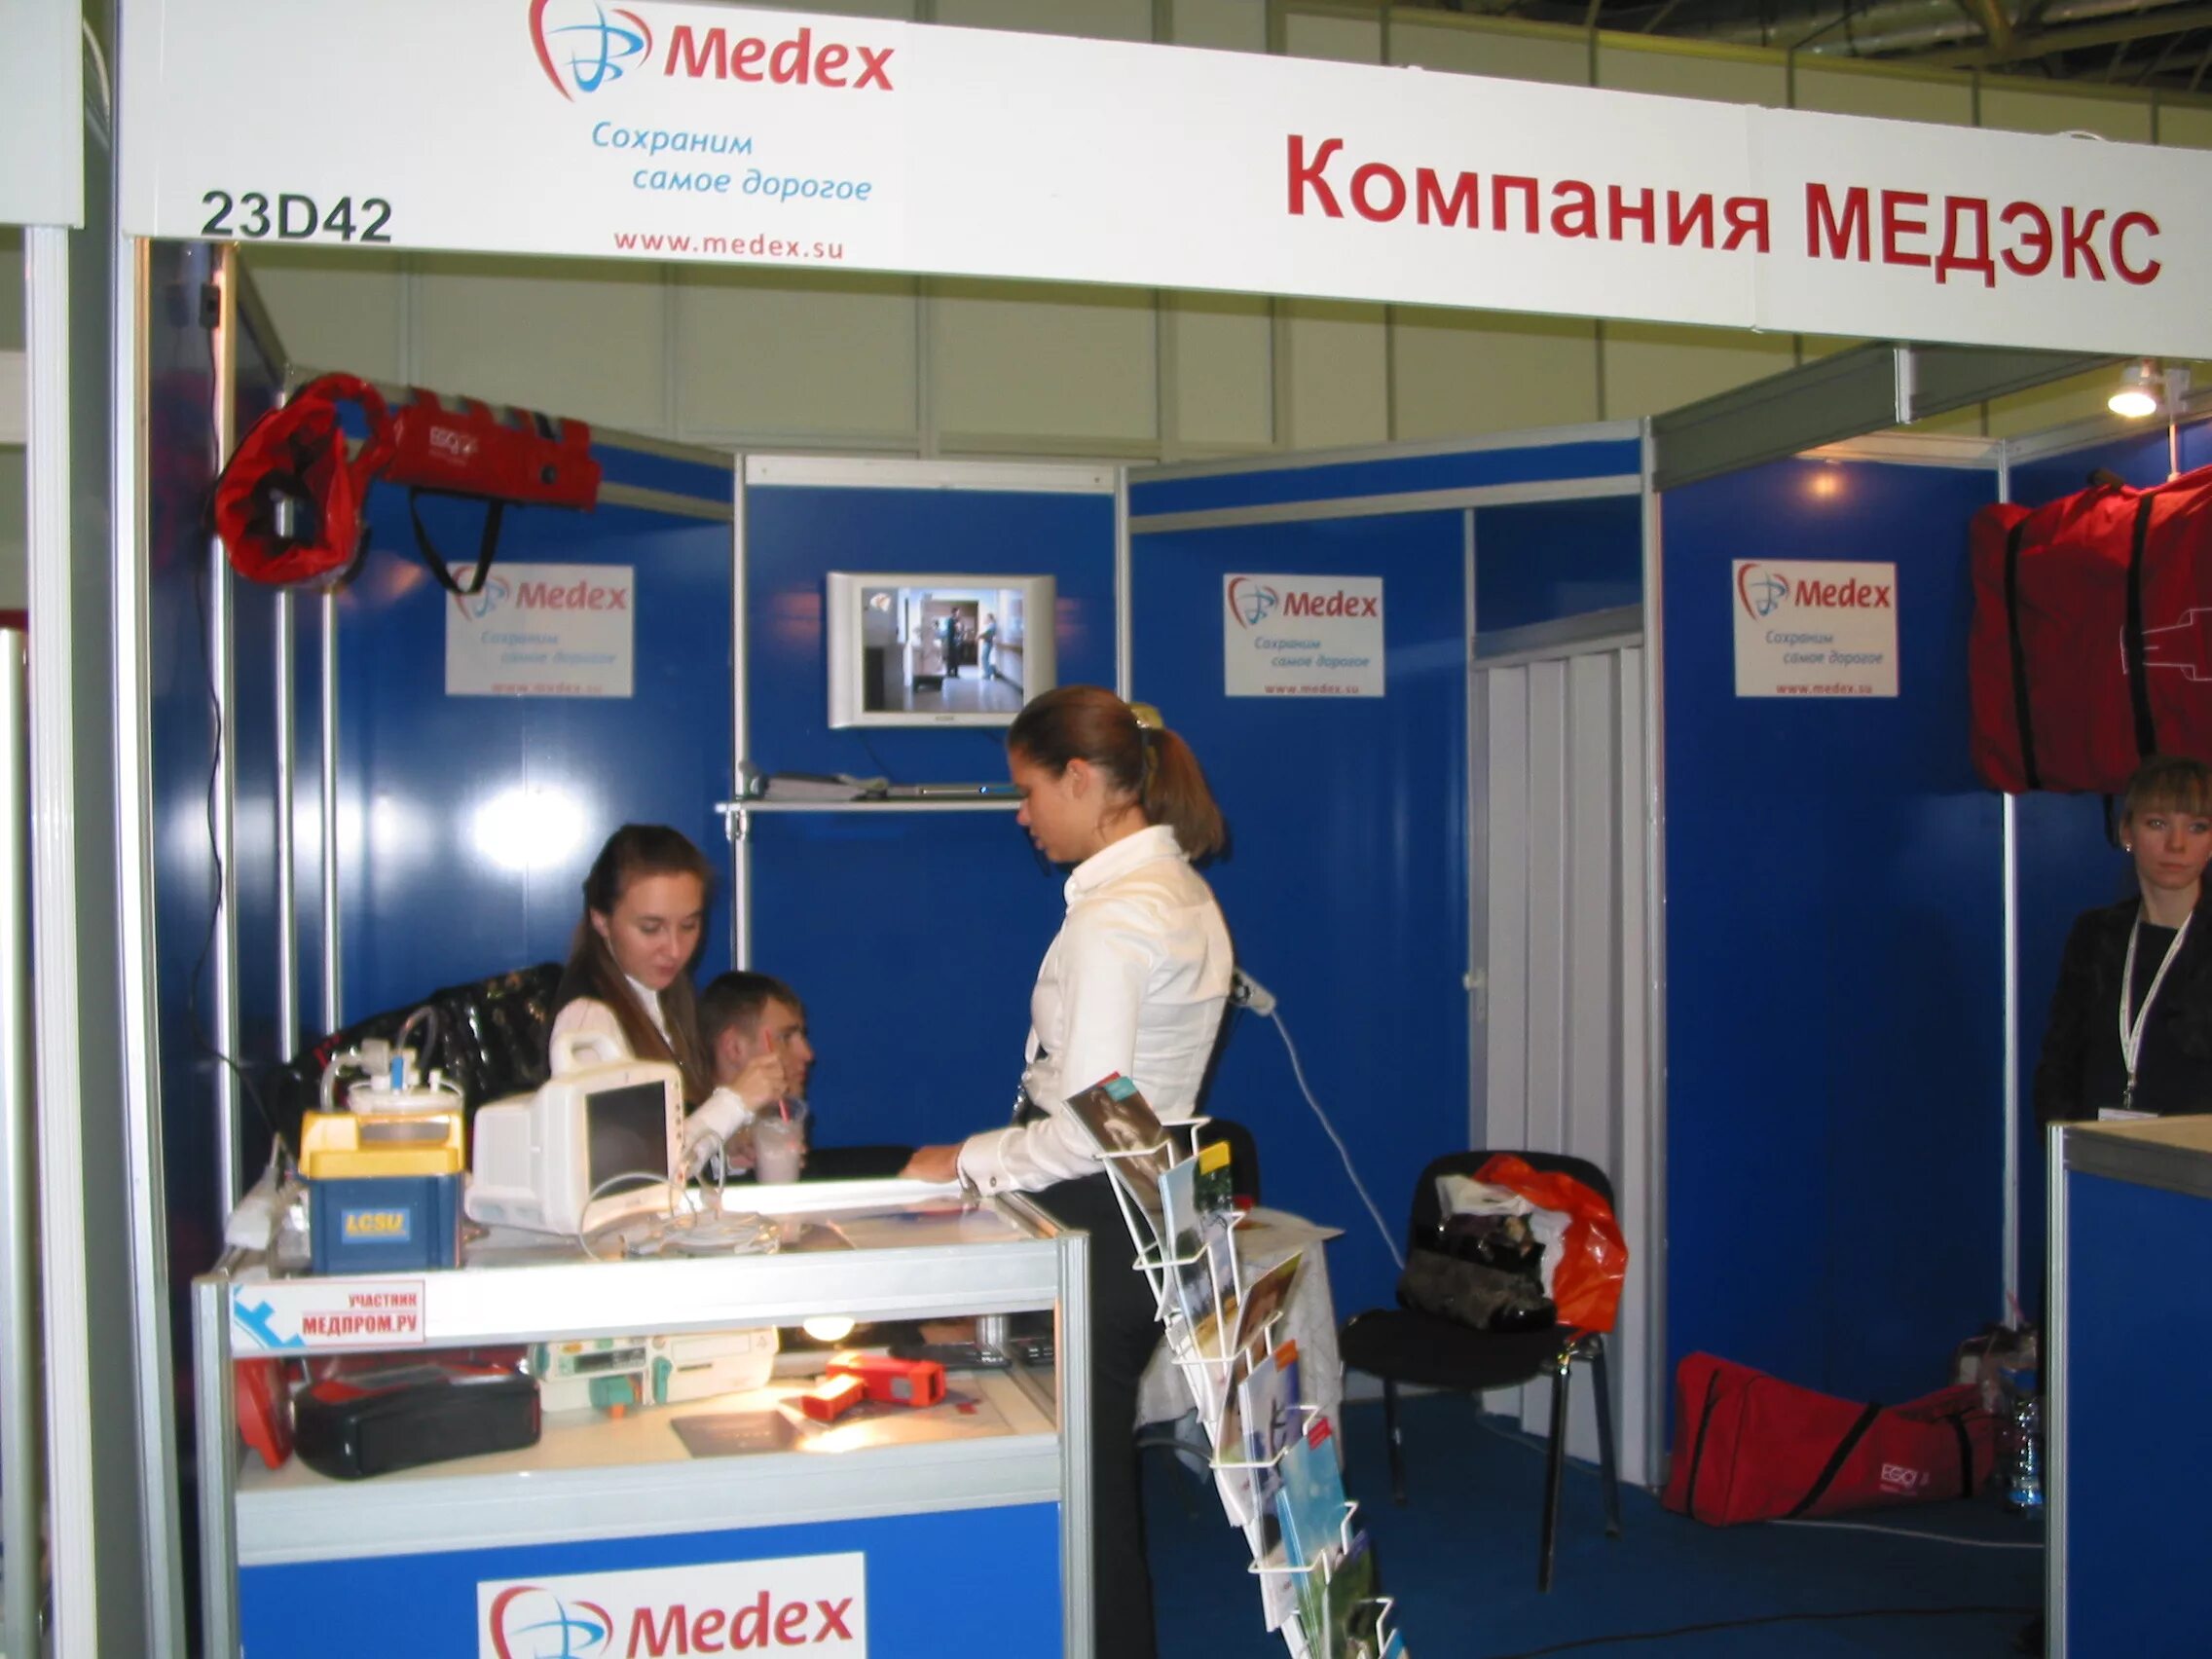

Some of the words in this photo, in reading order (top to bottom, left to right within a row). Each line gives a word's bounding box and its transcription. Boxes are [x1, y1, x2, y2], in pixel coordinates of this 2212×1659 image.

[663, 25, 896, 92] Medex
[591, 121, 754, 157] Сохраним
[633, 168, 732, 193] самое
[742, 167, 872, 203] дорогое
[201, 190, 391, 242] 23D42
[1285, 132, 1770, 254] Компания
[1804, 182, 2162, 288] МЕДЭКС
[613, 232, 844, 260] www.medex.su
[515, 578, 628, 610] Medex
[1282, 589, 1379, 618] Medex
[1794, 575, 1892, 608] Medex
[1254, 636, 1322, 651] Сохраним
[1765, 630, 1834, 646] Сохраним
[1271, 656, 1312, 668] самое
[1783, 652, 1825, 665] самое
[1264, 683, 1359, 694] www.medex.su
[1776, 682, 1873, 694] www.medex.su
[346, 1212, 404, 1235] LCSU
[349, 1292, 418, 1309] УЧАСТНИК
[302, 1315, 418, 1337] МЕДПРОМ.РУ
[626, 1590, 855, 1659] Medex
